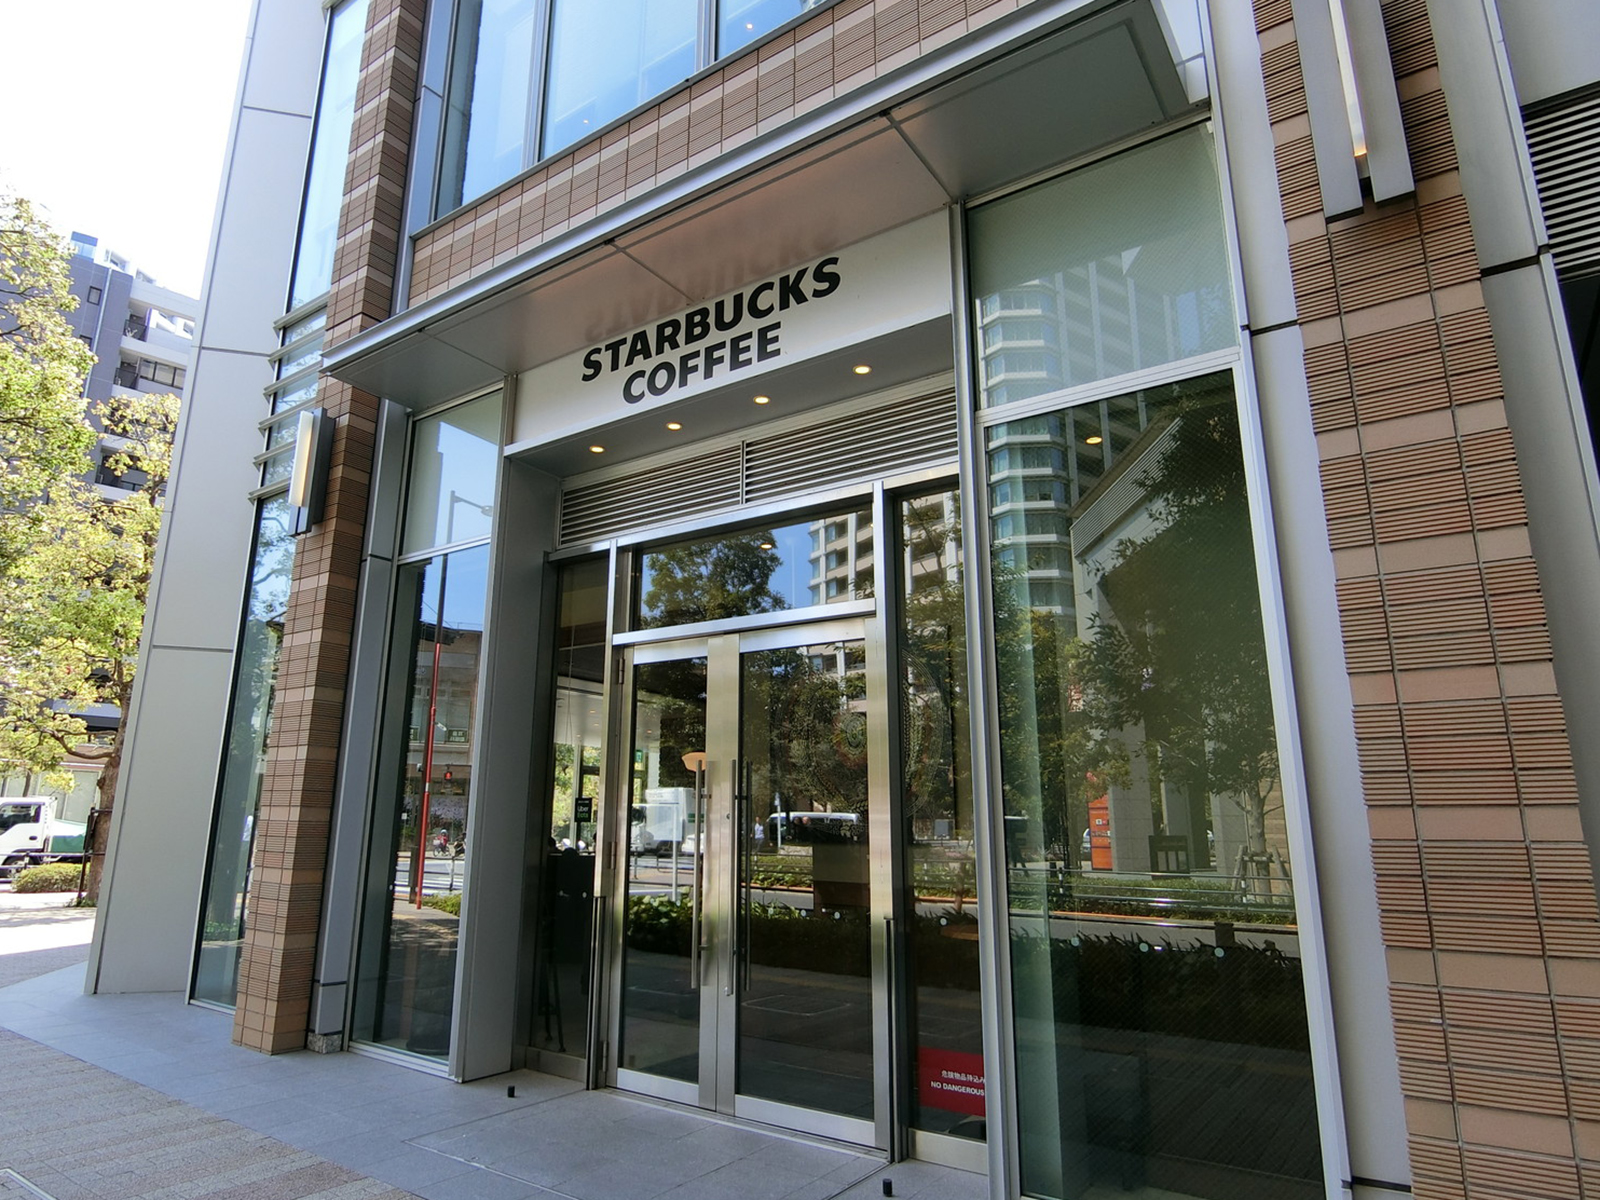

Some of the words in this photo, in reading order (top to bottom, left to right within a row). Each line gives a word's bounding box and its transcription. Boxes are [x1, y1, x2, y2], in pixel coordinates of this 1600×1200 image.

[581, 257, 841, 382] STARBUCKS
[622, 321, 782, 404] COFFEE
[930, 1080, 942, 1089] NO
[943, 1082, 985, 1096] DANGEROUS
